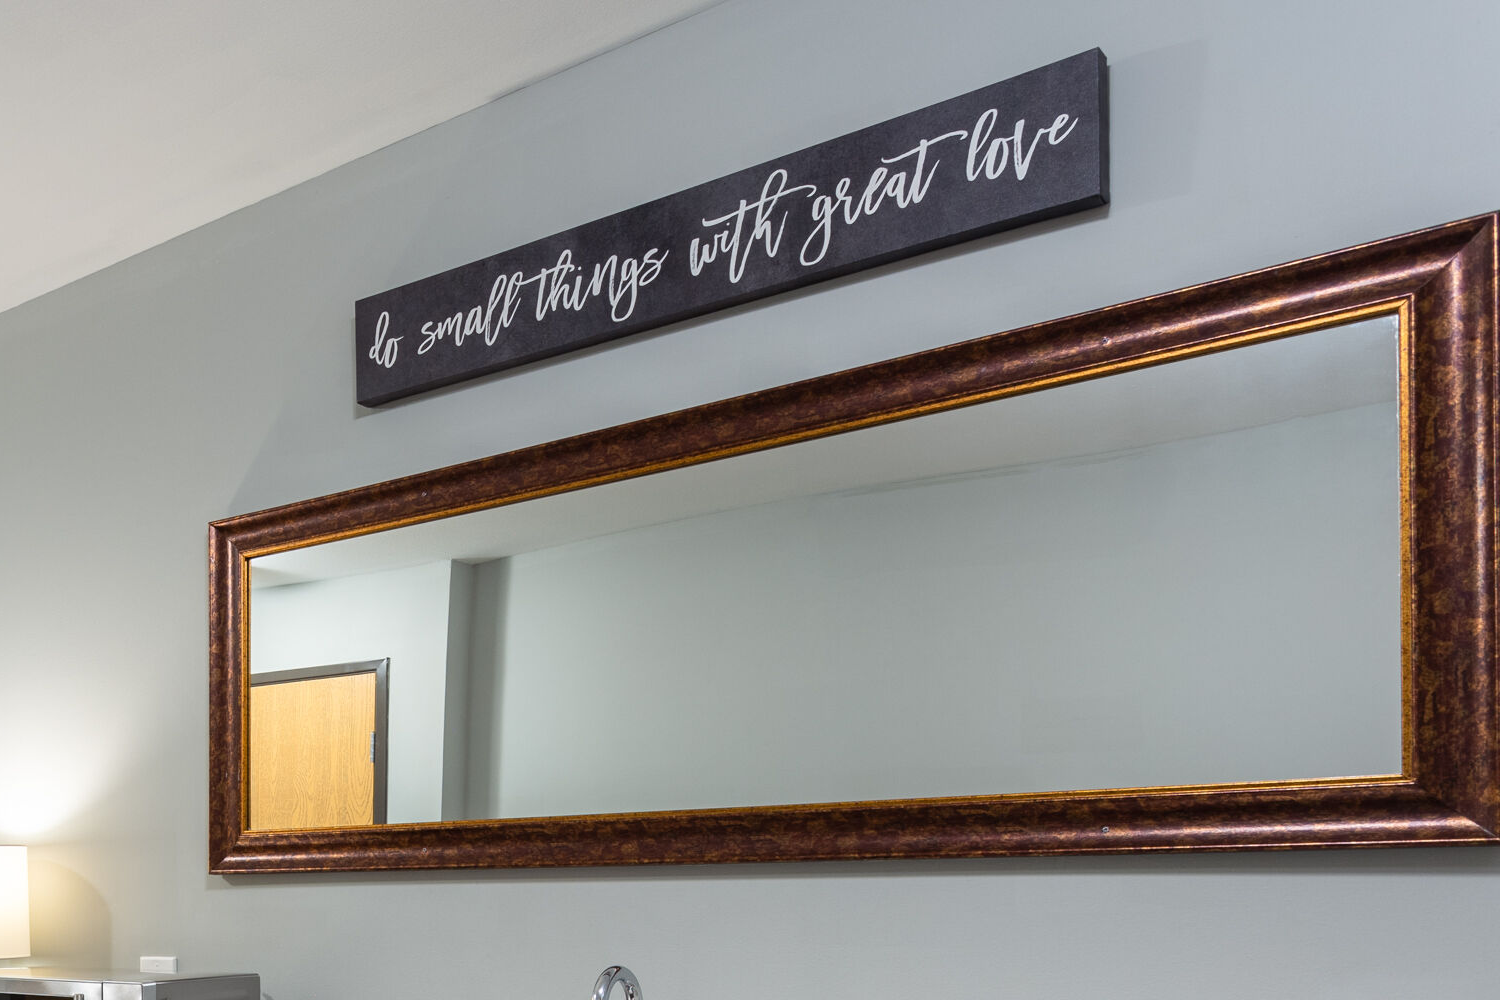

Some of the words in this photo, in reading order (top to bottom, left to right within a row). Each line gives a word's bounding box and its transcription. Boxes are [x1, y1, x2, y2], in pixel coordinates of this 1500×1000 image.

[368, 311, 404, 369] do
[417, 271, 524, 355] small
[518, 248, 669, 322] things
[689, 168, 817, 284] with
[799, 130, 968, 266] great
[966, 108, 1079, 182] love
